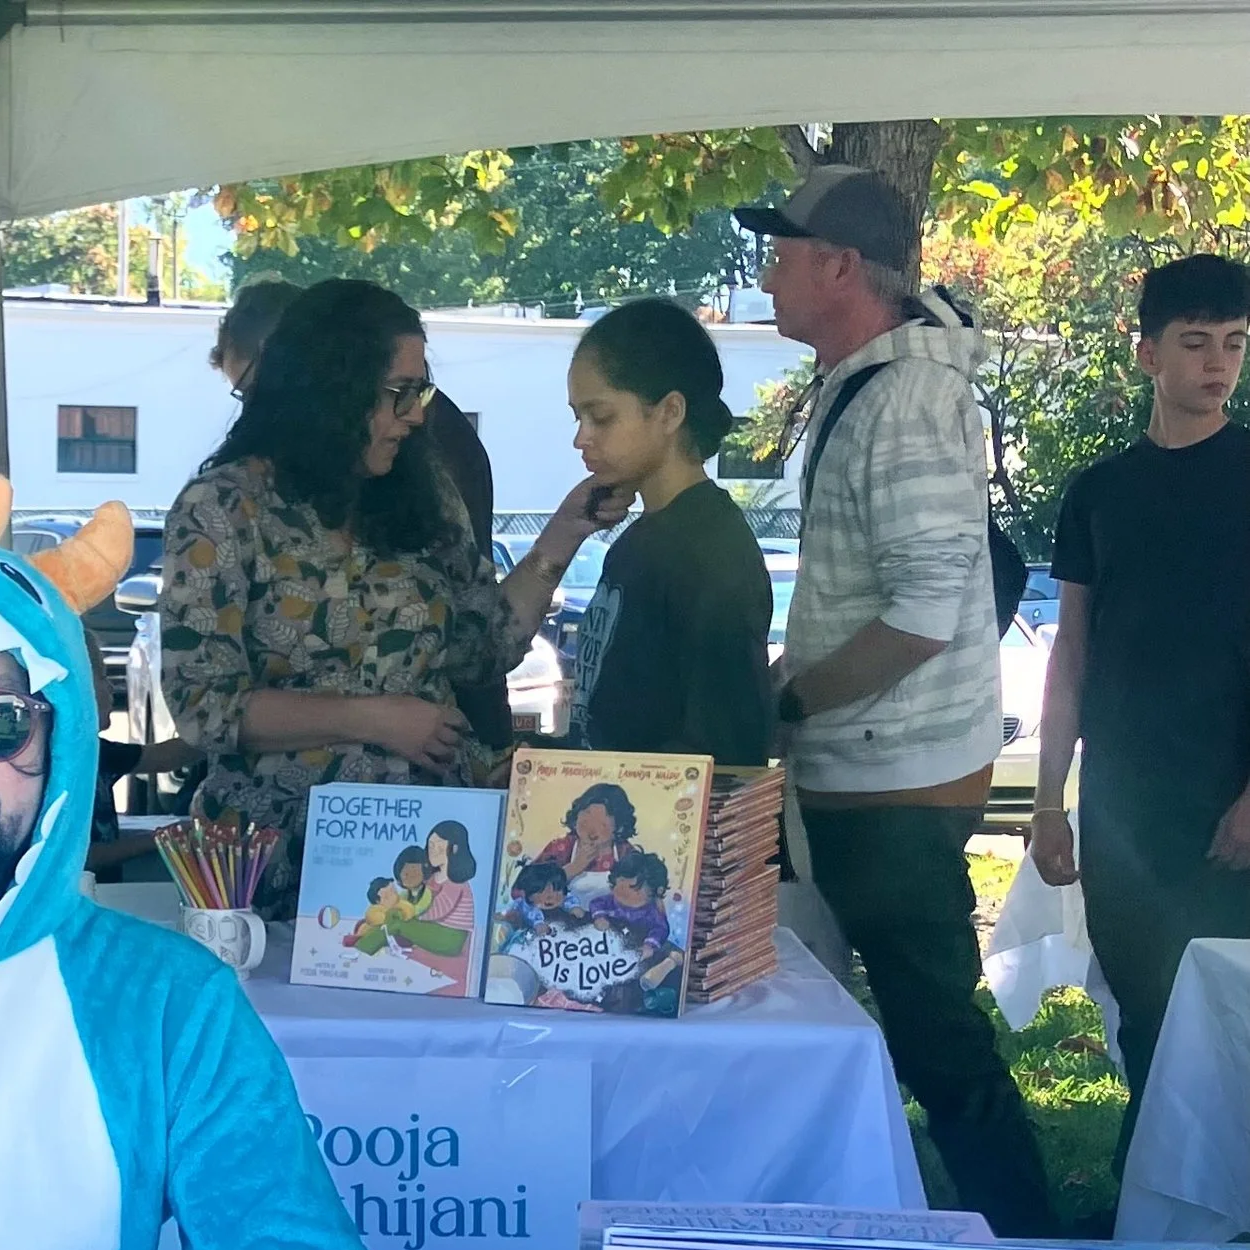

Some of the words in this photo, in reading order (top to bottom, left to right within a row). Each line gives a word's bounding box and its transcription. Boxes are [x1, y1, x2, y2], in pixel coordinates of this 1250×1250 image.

[318, 795, 423, 818] TOGETHER
[315, 819, 356, 840] FOR
[361, 822, 418, 843] MAMA
[538, 932, 609, 968] Bread
[553, 964, 570, 984] Is
[578, 957, 638, 991] Love
[350, 1183, 531, 1250] hijani
